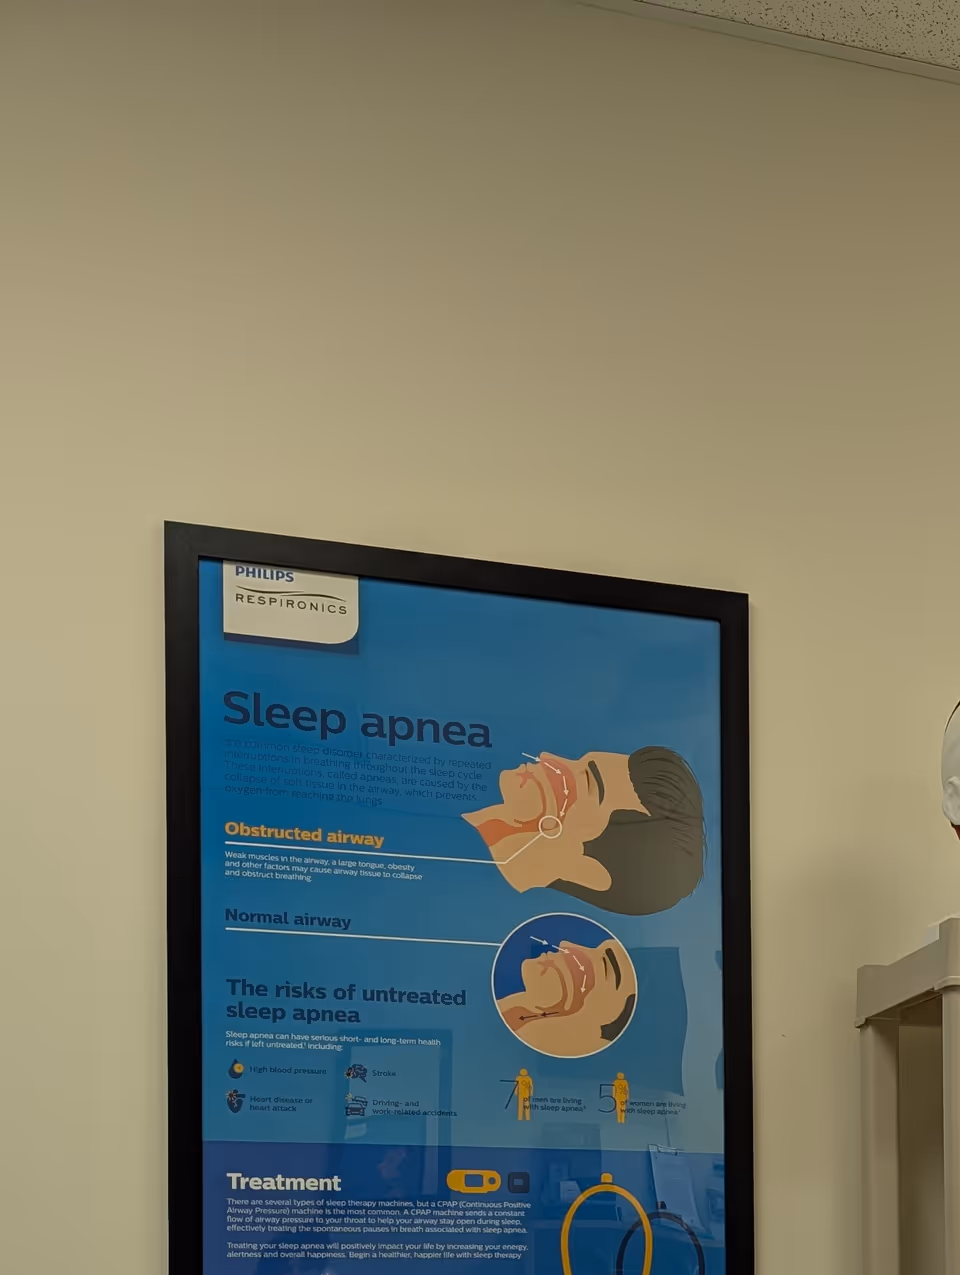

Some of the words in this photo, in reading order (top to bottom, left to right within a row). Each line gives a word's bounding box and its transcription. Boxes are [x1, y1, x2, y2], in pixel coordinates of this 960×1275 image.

[235, 565, 295, 582] PHILIPS
[235, 593, 348, 615] RESPIRONICS
[223, 690, 347, 740] Sleep
[360, 709, 492, 748] apnea
[224, 821, 323, 842] Obstructed
[327, 829, 385, 849] airway
[225, 851, 247, 859] Weak
[248, 854, 279, 862] muscles
[290, 855, 303, 863] the
[304, 857, 330, 867] airway,
[338, 859, 357, 868] large
[358, 860, 387, 870] tongue,
[388, 862, 416, 873] obesity
[242, 862, 263, 870] other
[264, 863, 290, 871] factors
[292, 866, 308, 874] may
[333, 867, 359, 877] airway
[360, 869, 382, 877] tissue
[392, 871, 423, 881] collapse
[242, 870, 274, 878] obstruct
[225, 908, 290, 925] Normal
[294, 912, 352, 931] airway
[226, 978, 268, 997] The
[275, 980, 327, 999] risks
[333, 983, 356, 1001] of
[362, 986, 466, 1006] untreated
[226, 1001, 286, 1024] sleep
[292, 1006, 361, 1025] apnea
[225, 1031, 248, 1041] Sleep
[249, 1033, 274, 1041] apnea
[291, 1033, 309, 1041] have
[311, 1034, 338, 1042] serious
[339, 1035, 362, 1043] short-
[380, 1036, 416, 1046] long-term
[418, 1038, 441, 1046] health
[245, 1040, 251, 1048] if
[249, 1066, 267, 1075] High
[269, 1065, 292, 1074] blood
[293, 1067, 327, 1076] pressure
[371, 1069, 397, 1077] Stroke
[249, 1095, 272, 1104] Heart
[273, 1095, 303, 1104] disease
[499, 1079, 519, 1110] 7
[598, 1083, 617, 1113] 5
[249, 1104, 270, 1112] heart
[272, 1104, 297, 1112] attack
[372, 1099, 402, 1108] Driving-
[372, 1107, 421, 1116] work-related
[422, 1109, 458, 1117] accidents
[226, 1172, 342, 1191] Treatment
[226, 1207, 253, 1216] Airway
[255, 1207, 290, 1216] Pressure)
[293, 1199, 315, 1208] types
[326, 1200, 347, 1208] sleep
[348, 1200, 377, 1209] therapy
[378, 1200, 416, 1208] machines,
[459, 1201, 502, 1209] (Continuous
[226, 1225, 266, 1233] effectively
[268, 1225, 297, 1234] treating
[312, 1225, 362, 1234] spontaneous
[482, 1226, 502, 1235] sleep
[227, 1243, 258, 1251] Treating
[278, 1243, 299, 1251] sleep
[341, 1243, 376, 1251] positively
[378, 1243, 403, 1251] impact
[436, 1243, 445, 1251] by
[447, 1243, 483, 1251] increasing
